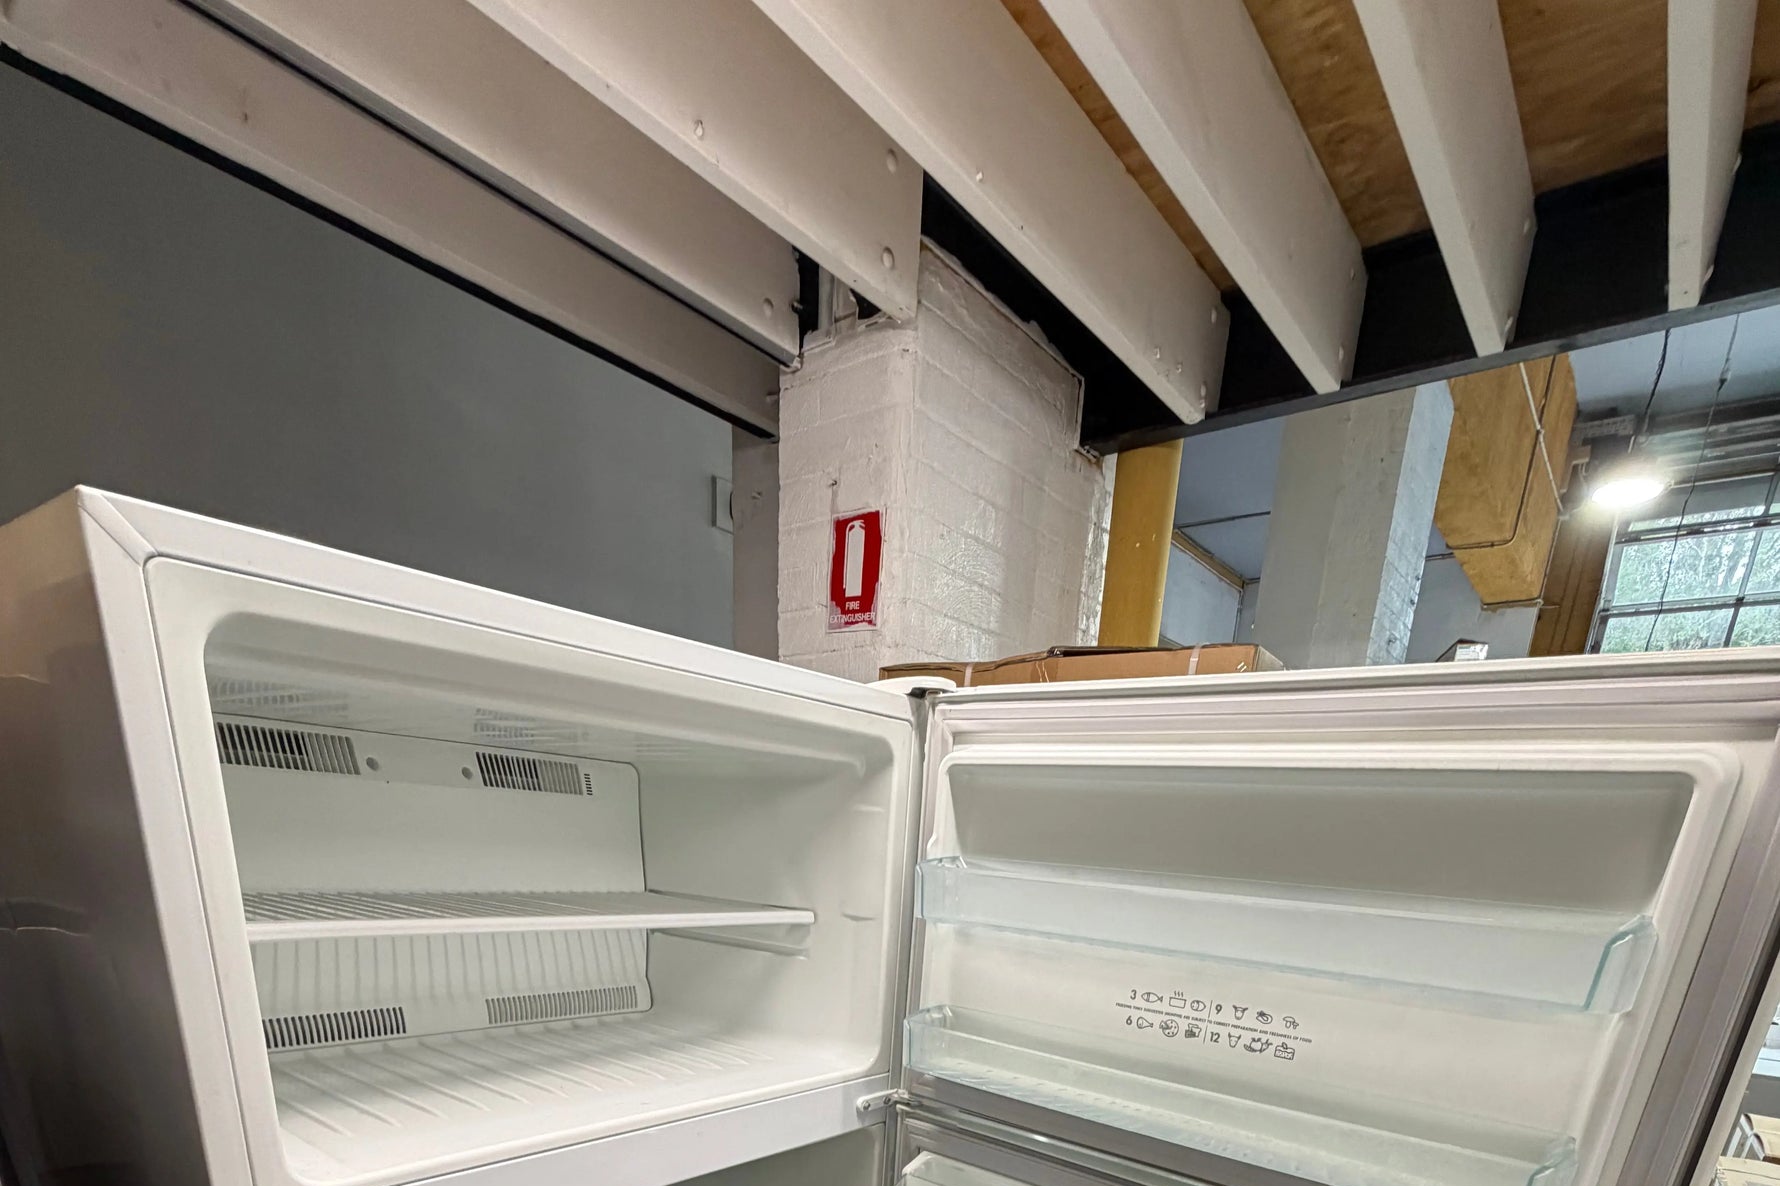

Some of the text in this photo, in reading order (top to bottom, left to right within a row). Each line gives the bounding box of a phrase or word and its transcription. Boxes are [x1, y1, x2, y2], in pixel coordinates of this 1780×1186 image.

[845, 600, 860, 611] FIRE
[829, 612, 876, 624] EXTINGUISHER
[1130, 989, 1137, 1000] 3
[1215, 1004, 1223, 1015] 9
[1126, 1015, 1133, 1026] 6
[1209, 1031, 1221, 1043] 12
[1231, 1024, 1258, 1033] PREPARATION
[1269, 1031, 1292, 1040] FRESHNESS
